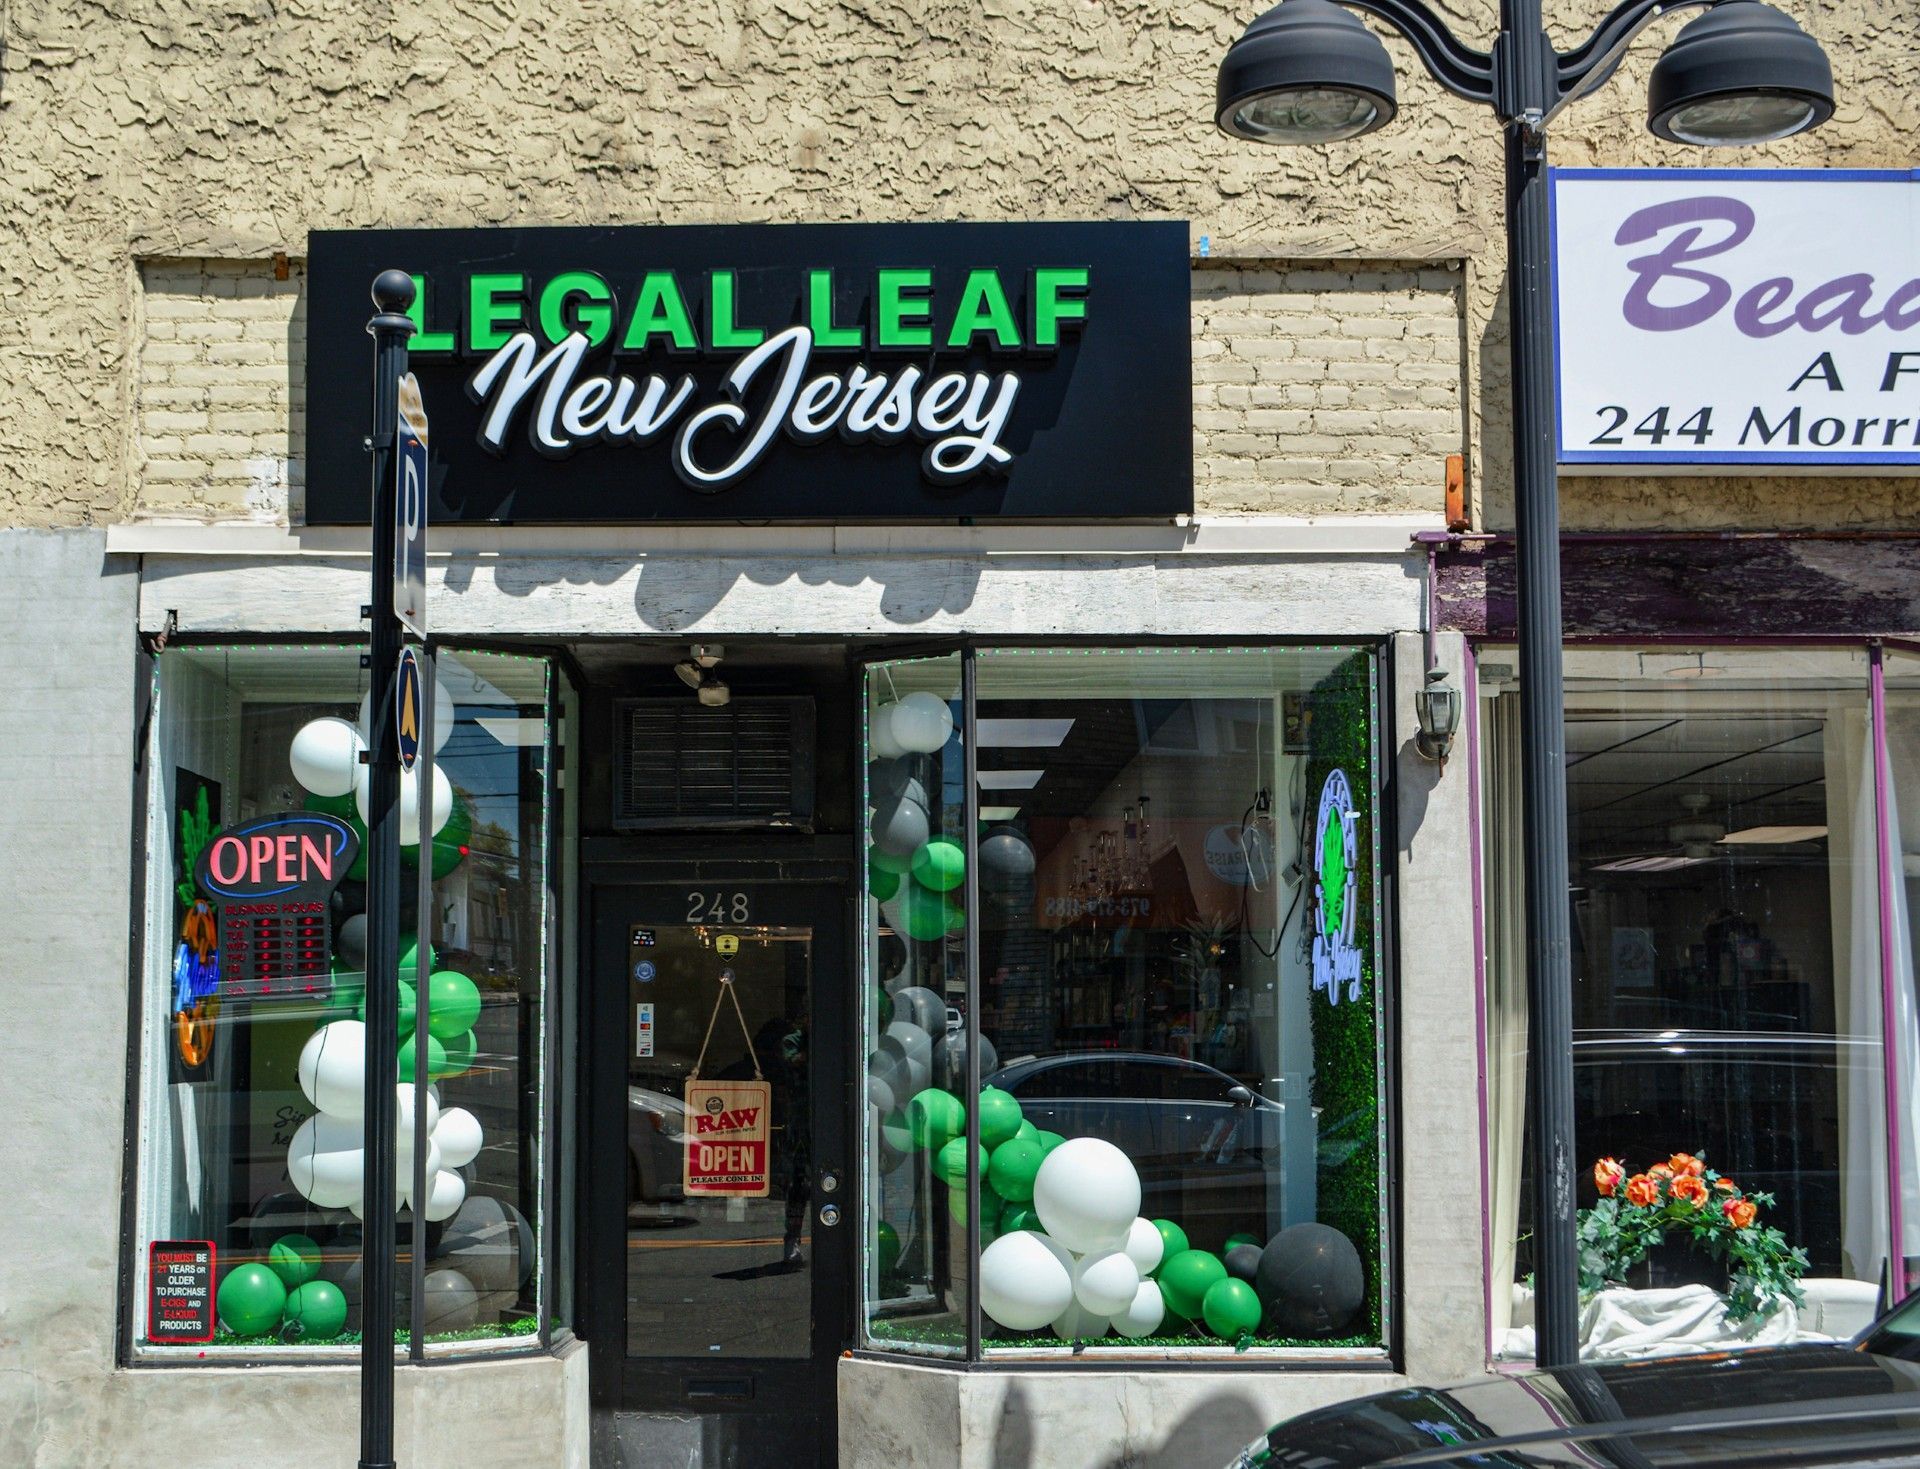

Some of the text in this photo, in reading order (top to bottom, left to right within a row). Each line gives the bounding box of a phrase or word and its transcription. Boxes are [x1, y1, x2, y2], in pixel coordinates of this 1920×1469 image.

[406, 268, 1090, 351] LEGAL LEAF
[1787, 351, 1844, 392] A
[473, 326, 1020, 483] New Jersey
[1589, 406, 1713, 445] 244
[210, 834, 332, 885] OPEN
[225, 901, 324, 915] BUSINESS HOURS
[687, 891, 749, 923] 248
[694, 1107, 761, 1134] RAW
[699, 1145, 755, 1172] OPEN
[690, 1176, 724, 1184] PLEASE
[157, 1253, 208, 1263] YOU MUST BE
[169, 1264, 196, 1274] YEARS
[168, 1275, 195, 1285] OLDER
[156, 1286, 207, 1297] TO PURCHASE
[161, 1298, 201, 1308] E-CIGS AND
[159, 1320, 202, 1330] PRODUCTS
